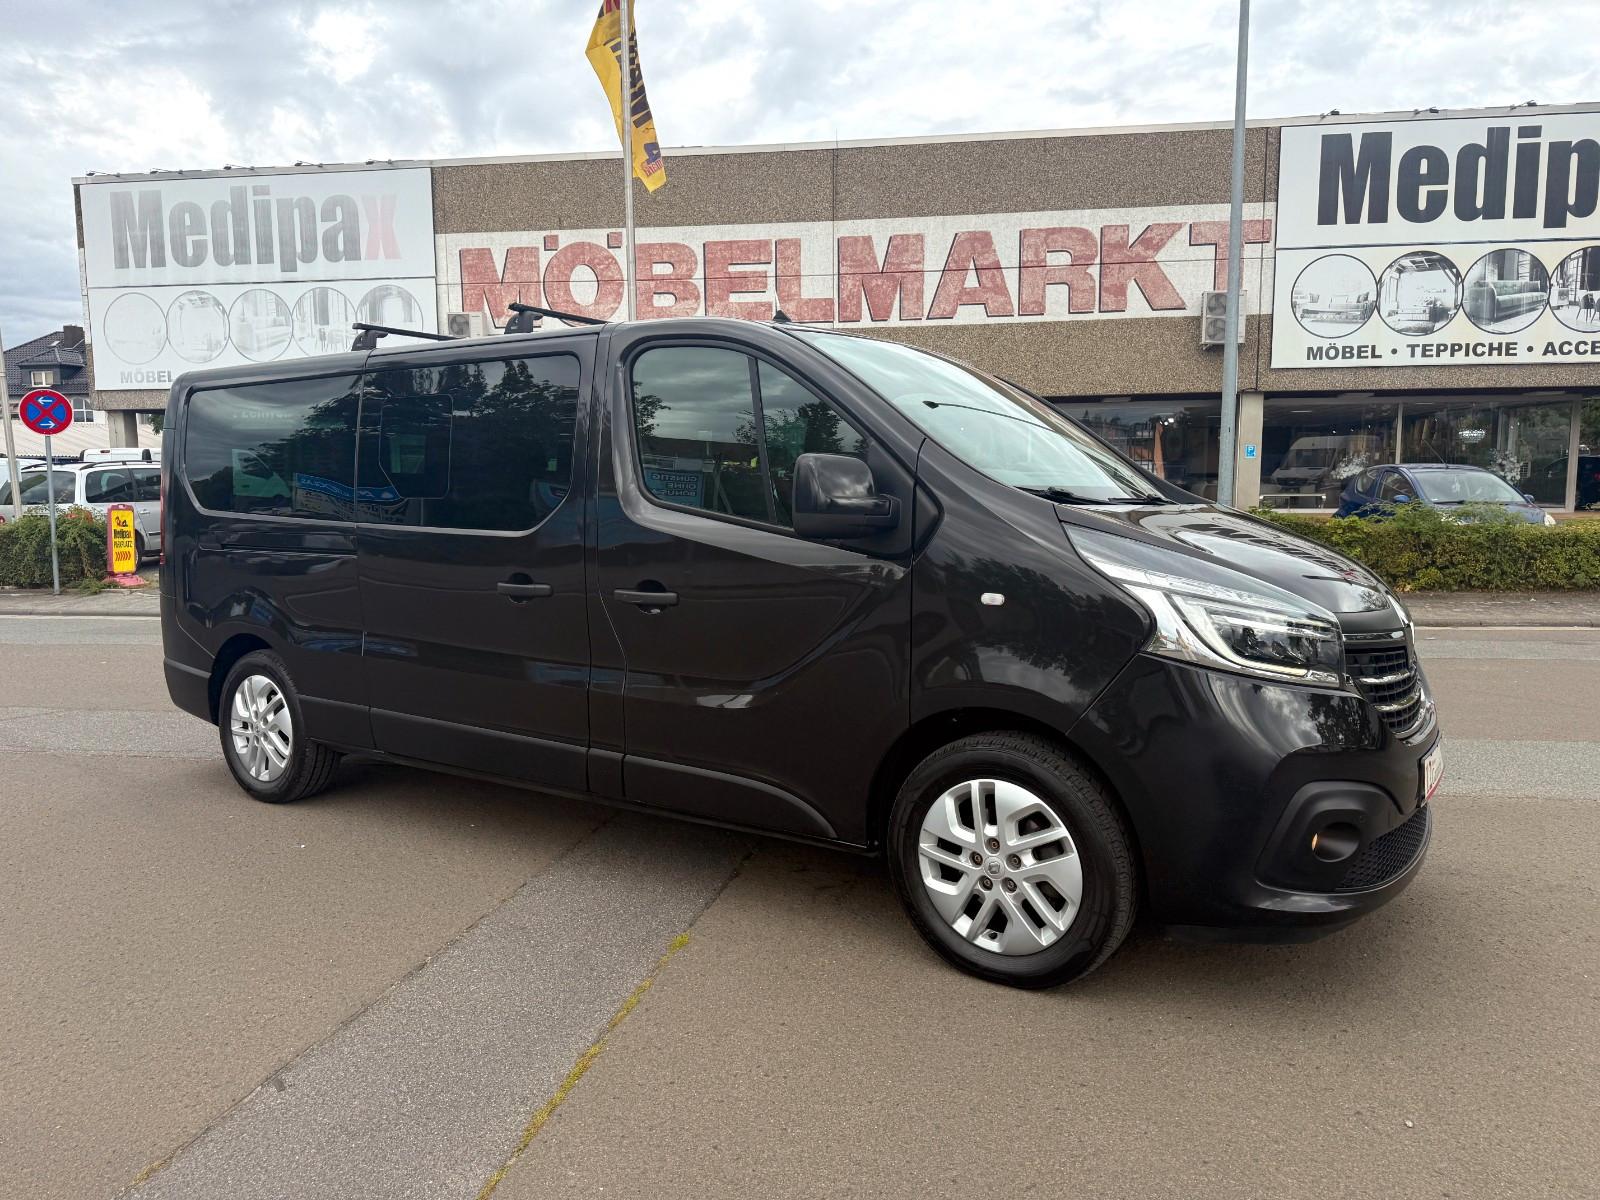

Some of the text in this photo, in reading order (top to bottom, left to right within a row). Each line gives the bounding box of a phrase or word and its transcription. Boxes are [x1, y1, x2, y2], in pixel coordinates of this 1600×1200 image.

[1317, 125, 1600, 229] Medip
[109, 184, 402, 273] Medipax
[459, 218, 1272, 329] MÖBELMARKT
[120, 367, 174, 384] MÖBEL
[1306, 340, 1600, 361] MÖBEL TEPPICHE ACCE
